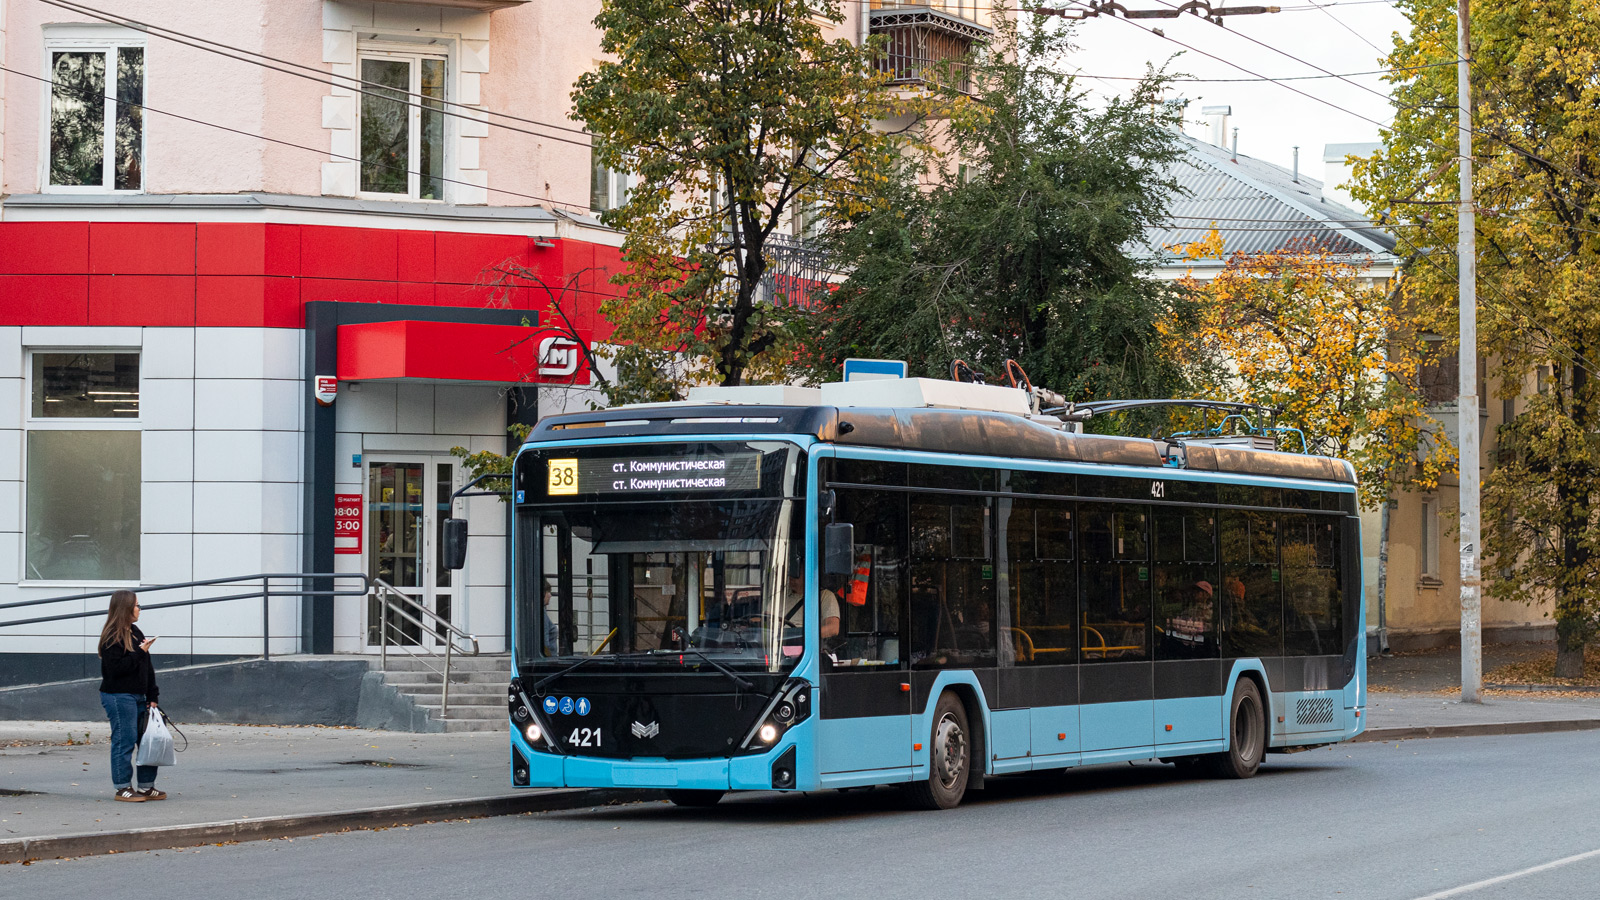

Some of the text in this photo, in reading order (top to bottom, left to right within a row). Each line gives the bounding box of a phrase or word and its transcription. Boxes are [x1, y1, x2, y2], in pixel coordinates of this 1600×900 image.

[612, 459, 726, 474] ст. Коммунистическая
[552, 467, 574, 487] 38
[612, 476, 726, 491] ст. Коммунистическая
[1151, 481, 1165, 498] 421
[568, 727, 602, 747] 421
